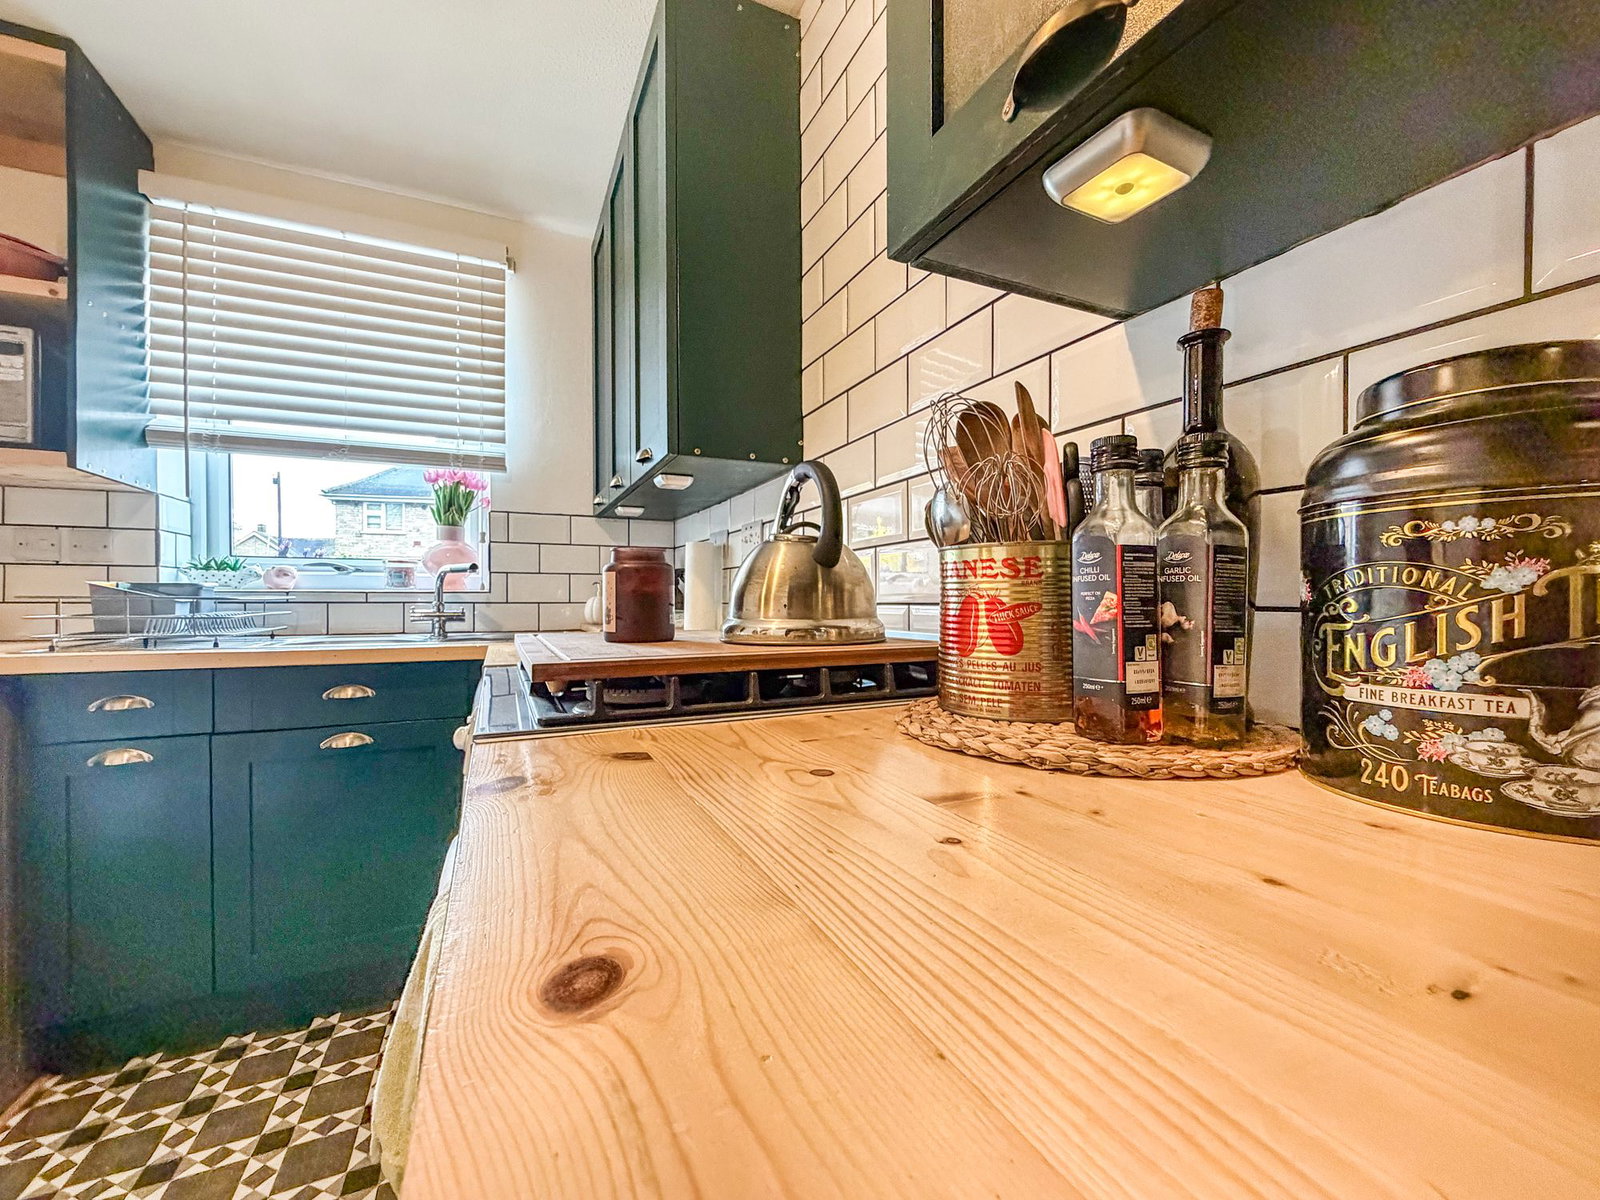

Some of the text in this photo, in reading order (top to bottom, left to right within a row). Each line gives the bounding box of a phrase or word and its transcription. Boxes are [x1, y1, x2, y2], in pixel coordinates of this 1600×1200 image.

[1079, 566, 1100, 575] CHILLI
[1164, 566, 1192, 575] GARLIC
[1072, 574, 1111, 583] NFUSED OIL
[1187, 574, 1202, 582] OIL
[1323, 566, 1474, 600] TRADITIONAL
[991, 604, 1039, 623] THICK SAUCE
[1319, 592, 1526, 685] ENGLISH
[1002, 661, 1017, 672] AU
[1021, 661, 1042, 673] JUS
[992, 680, 1041, 692] TOMATEN
[1359, 687, 1518, 715] FINE BREAKFAST TEA
[1360, 757, 1495, 804] 240 TEABAGS
